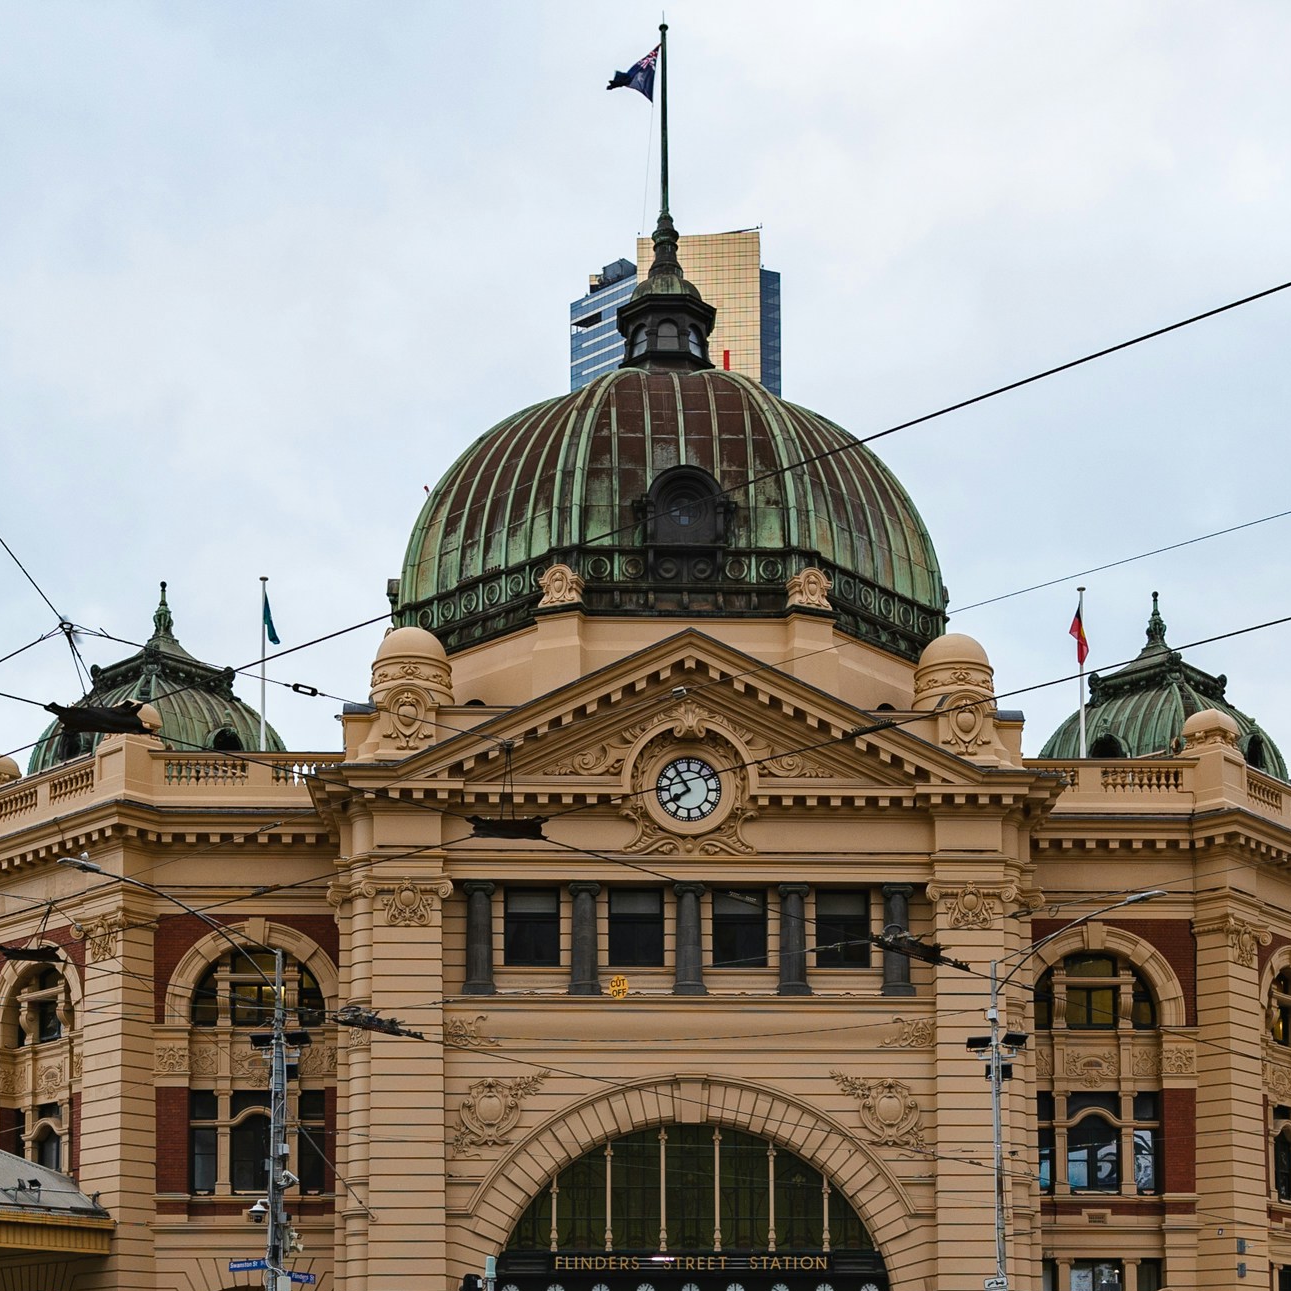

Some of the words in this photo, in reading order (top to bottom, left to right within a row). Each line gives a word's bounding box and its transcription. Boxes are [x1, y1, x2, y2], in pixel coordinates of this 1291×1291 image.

[230, 1261, 252, 1269] Swanston
[555, 1256, 640, 1270] FLINDERS
[663, 1256, 728, 1270] STREET
[749, 1256, 828, 1270] STATION
